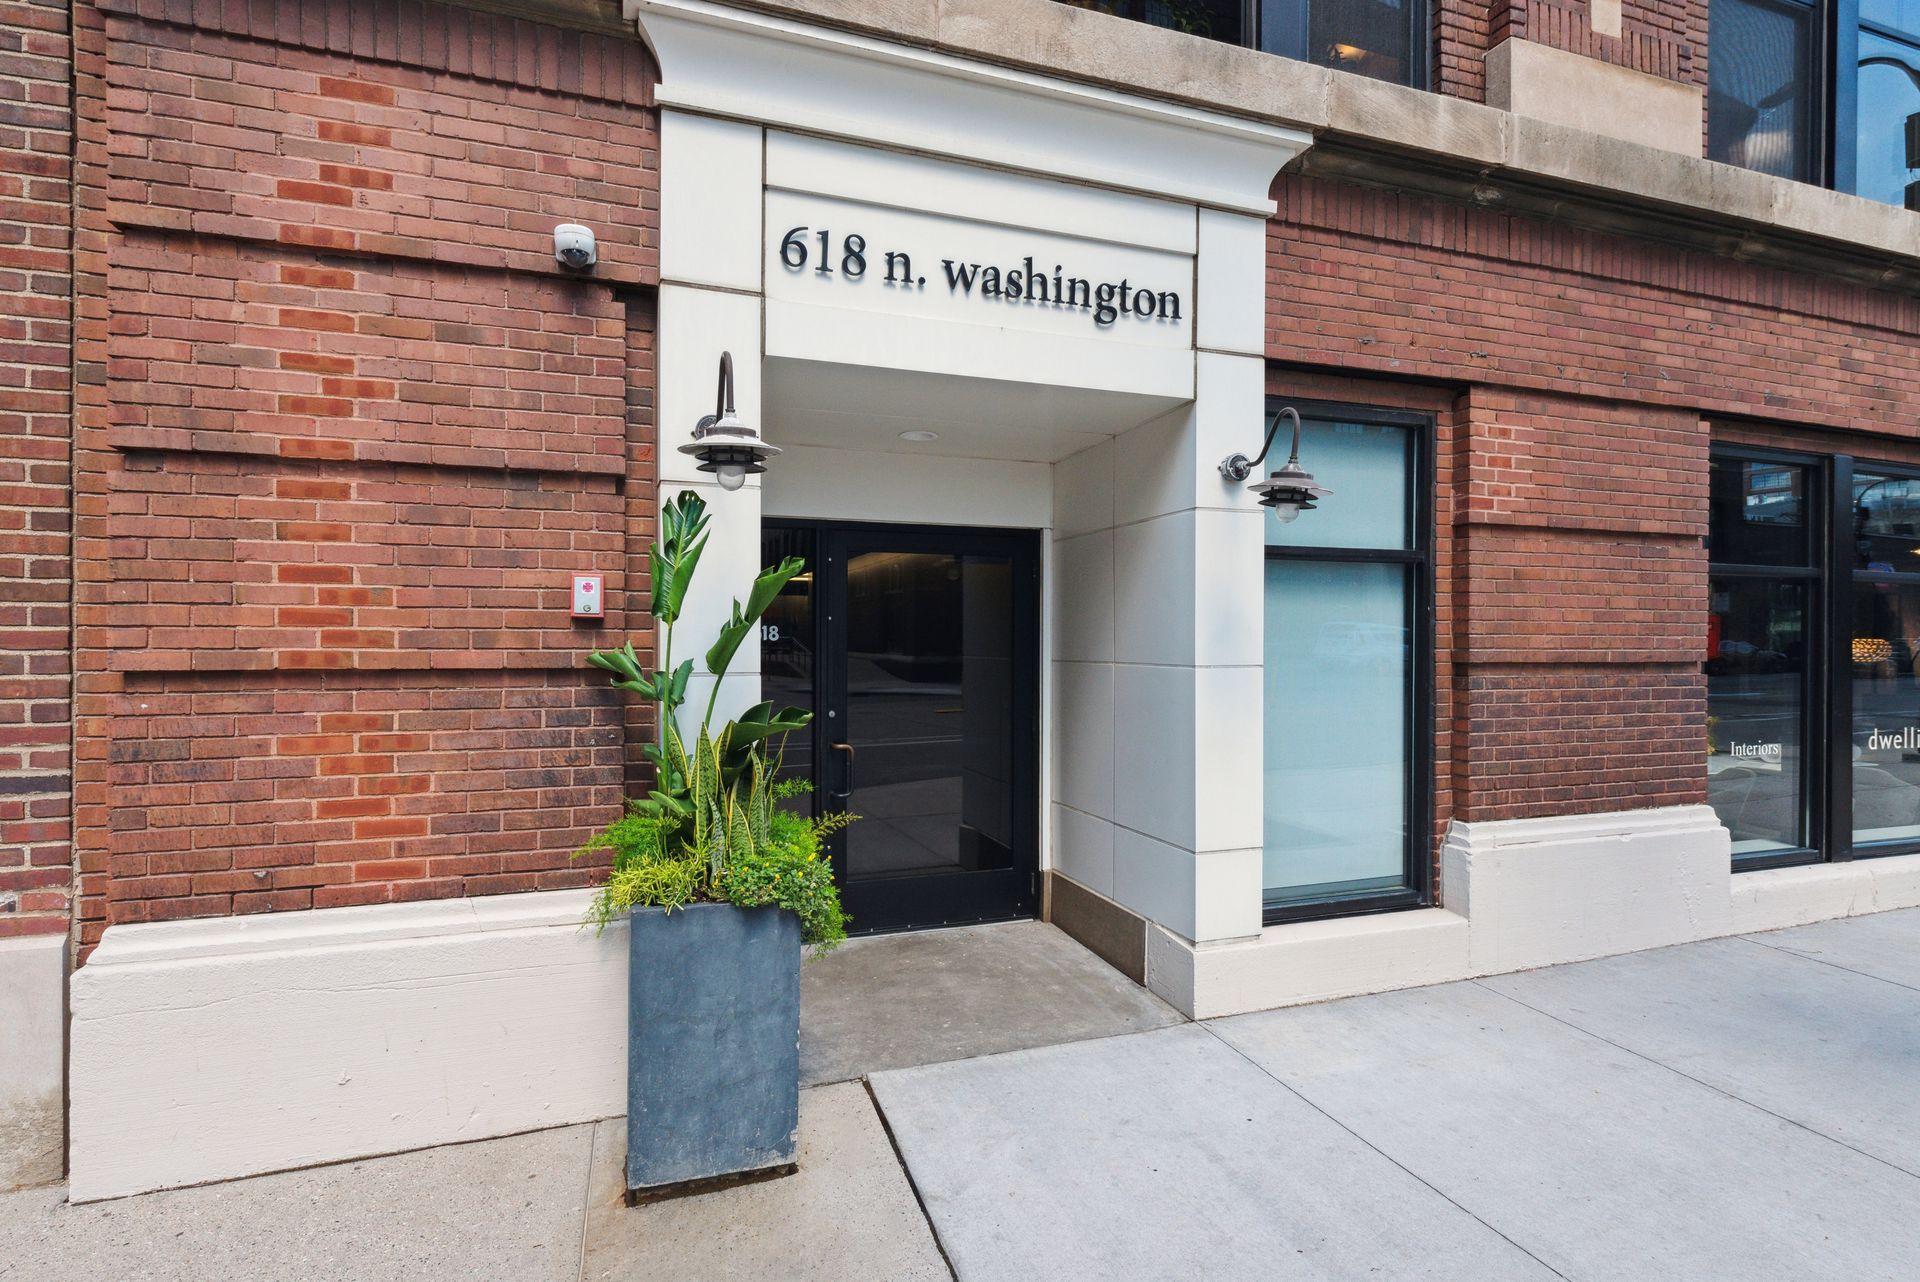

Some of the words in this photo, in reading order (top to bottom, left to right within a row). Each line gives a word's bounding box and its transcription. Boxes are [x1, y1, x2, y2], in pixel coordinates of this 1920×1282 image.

[780, 226, 867, 277] 618
[883, 251, 926, 286] n.
[941, 257, 1182, 325] washington
[761, 625, 779, 641] 18
[1730, 740, 1779, 757] Interiors
